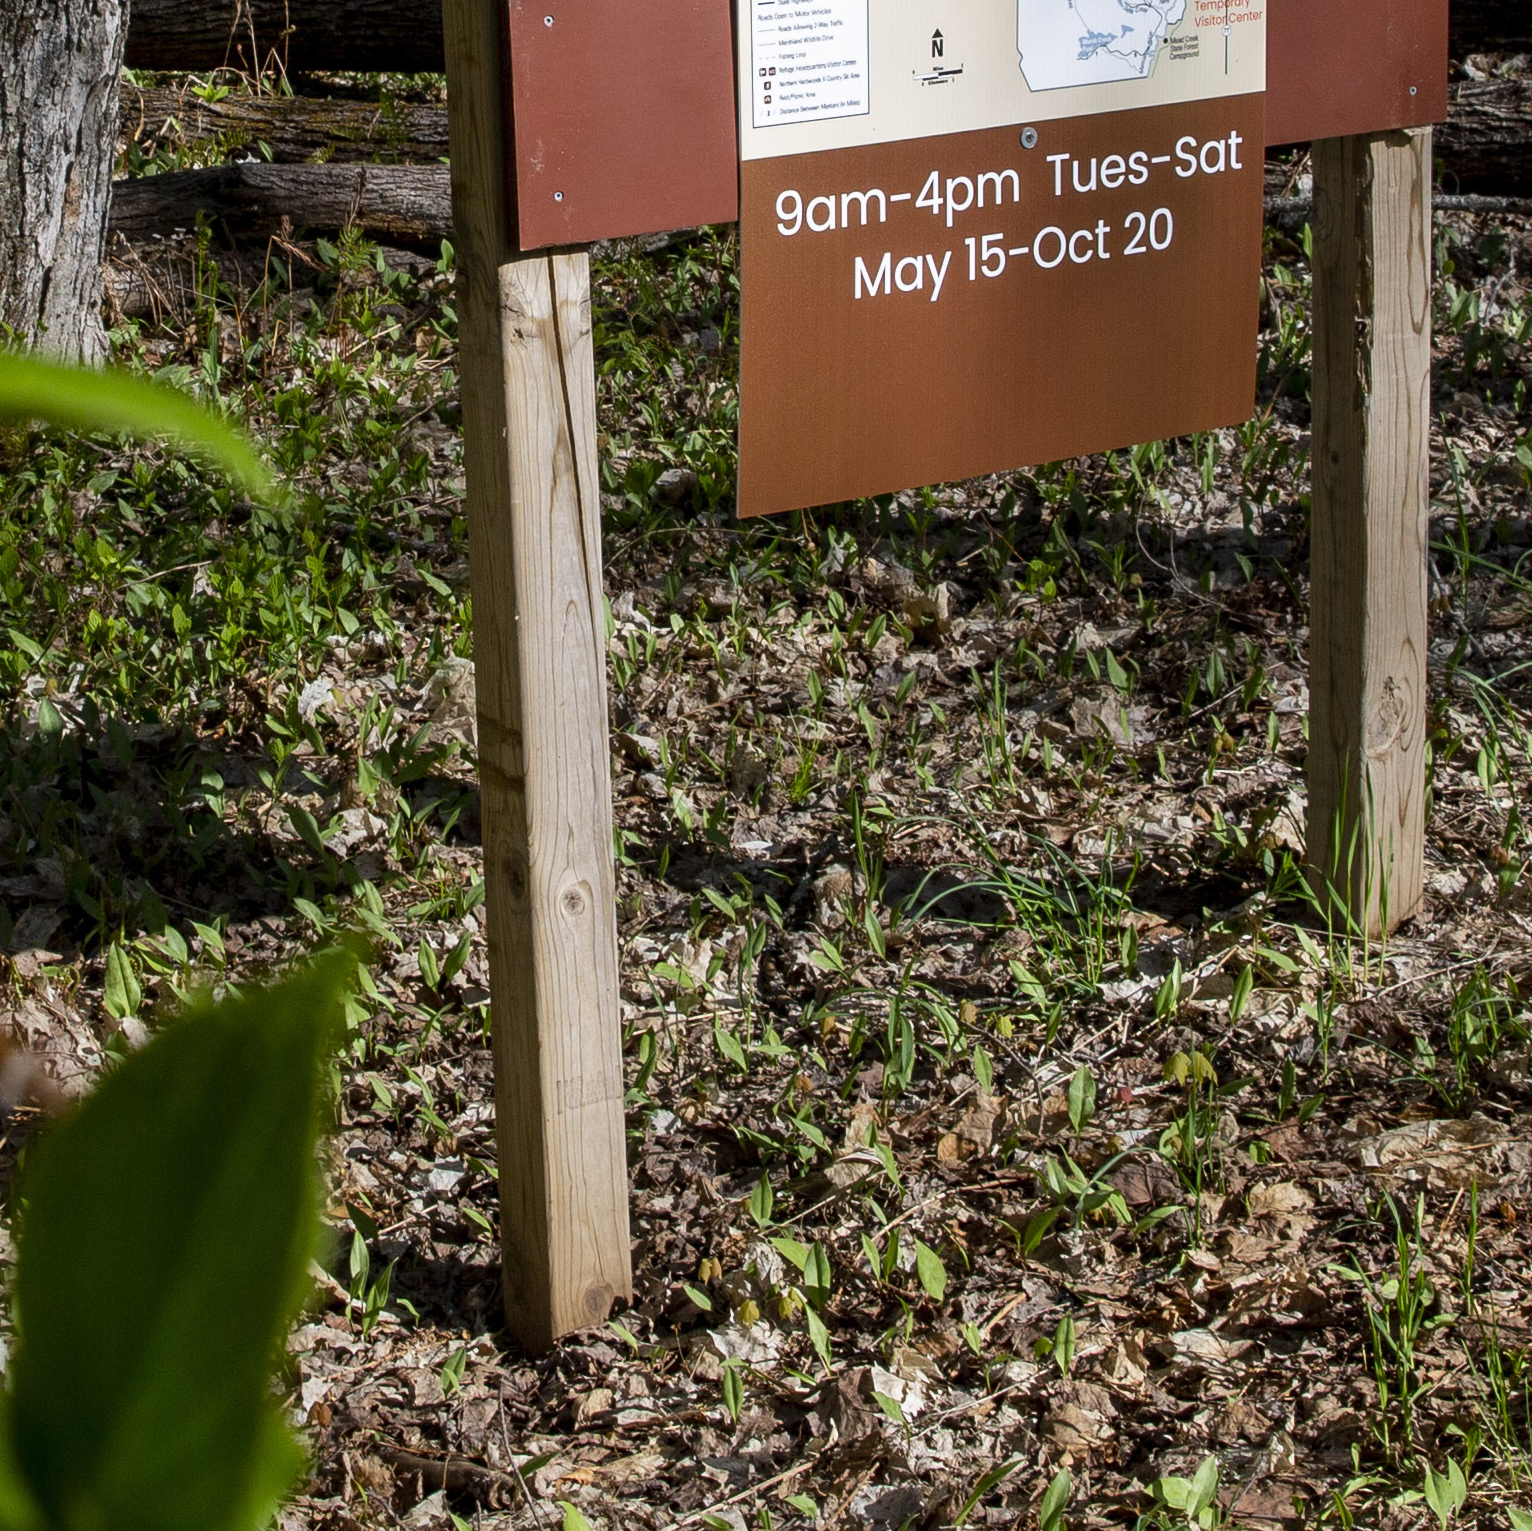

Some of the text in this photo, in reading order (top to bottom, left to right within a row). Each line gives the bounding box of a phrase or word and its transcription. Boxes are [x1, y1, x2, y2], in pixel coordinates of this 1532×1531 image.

[1194, 11, 1263, 28] Visitor Center
[931, 39, 944, 58] N
[775, 130, 1243, 236] 9am-4pm Tues-Sat
[853, 207, 1174, 302] May 15-Oct 20
